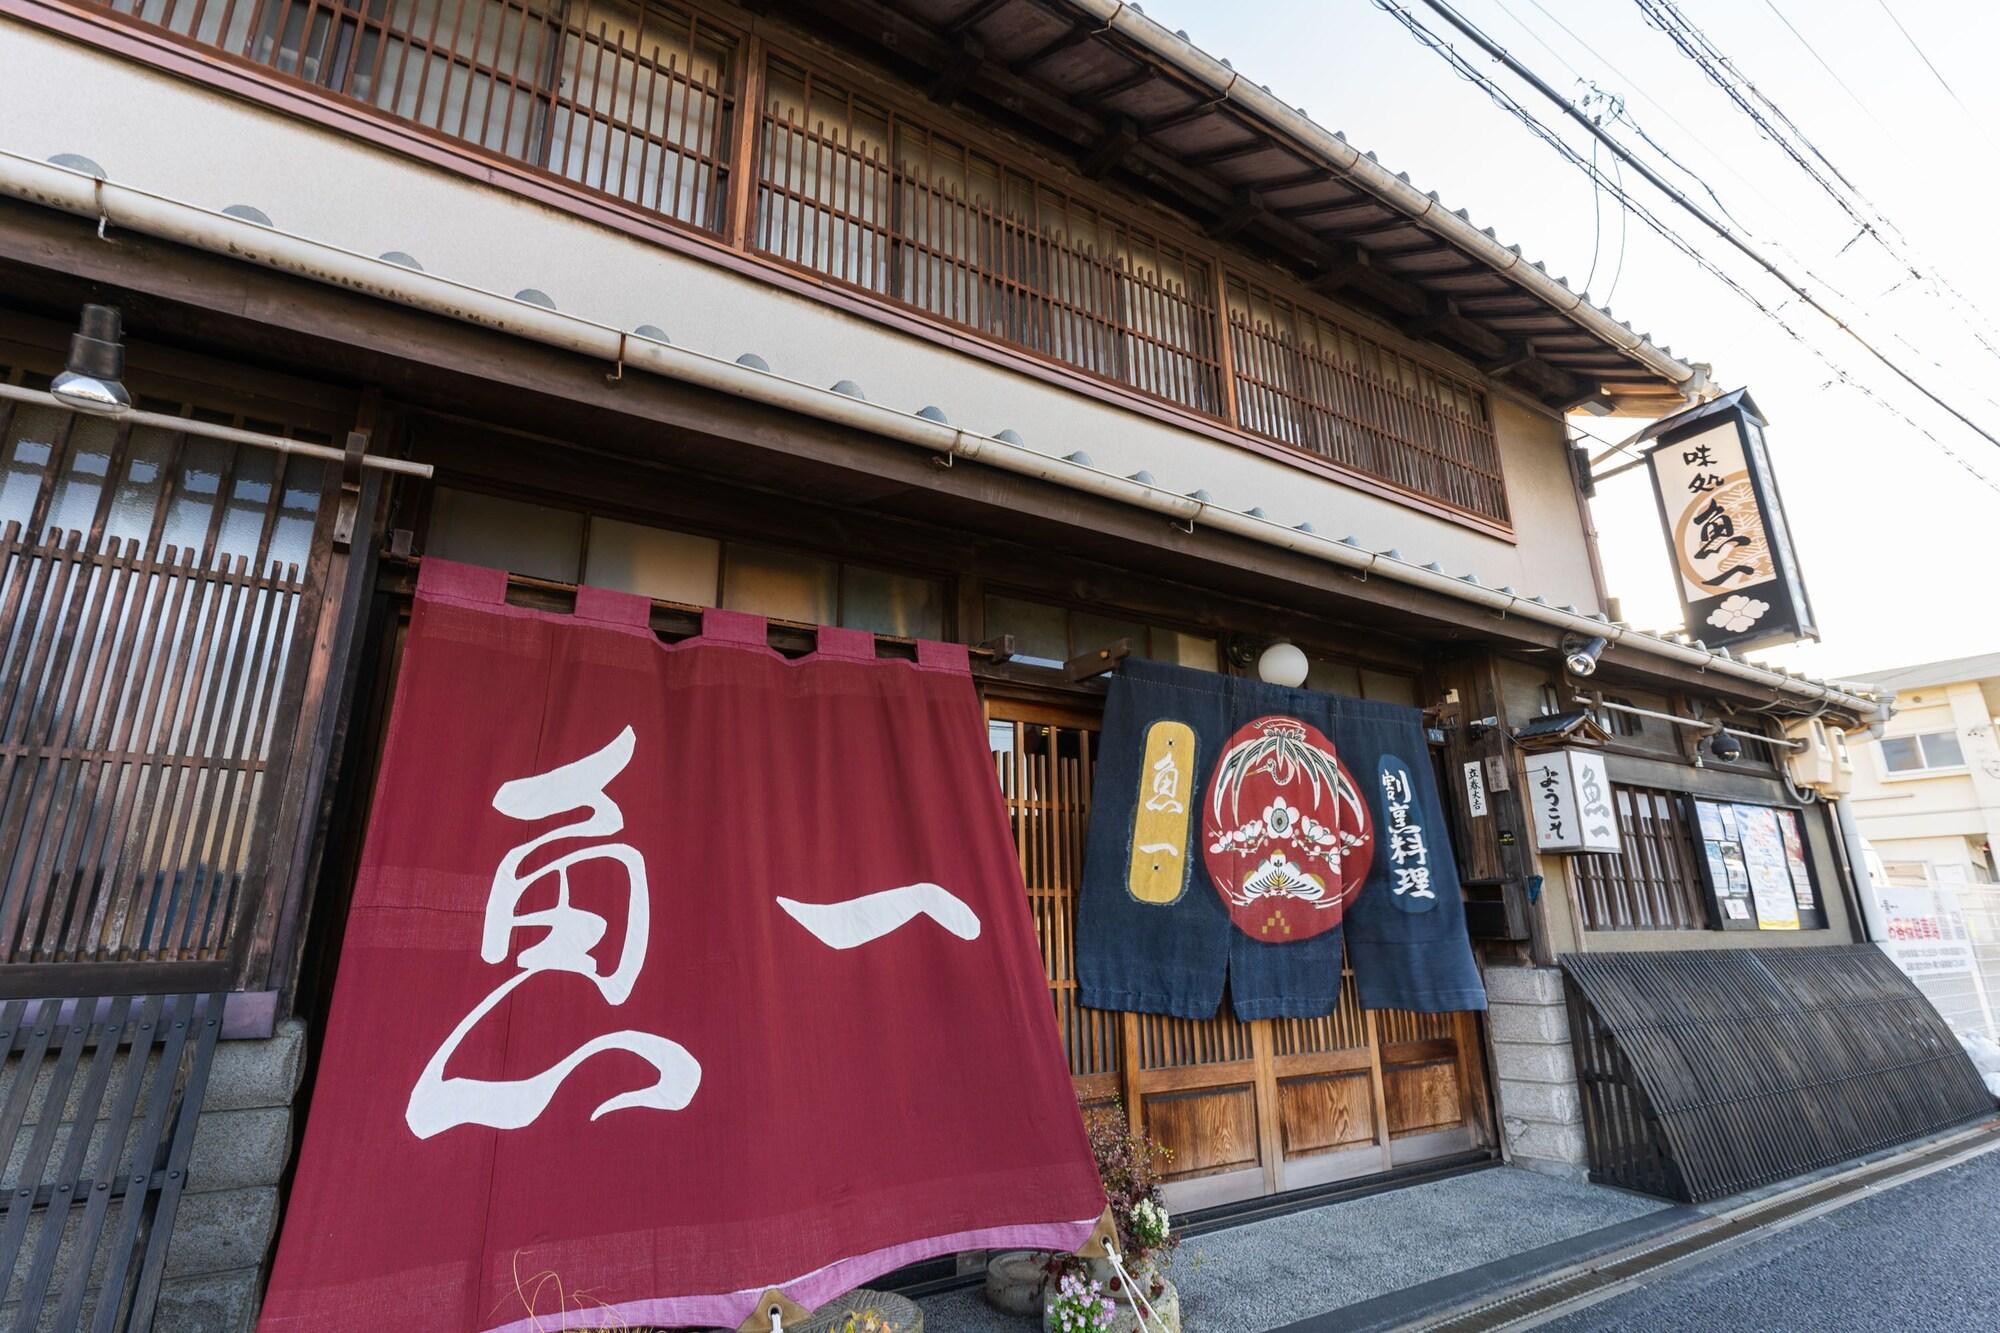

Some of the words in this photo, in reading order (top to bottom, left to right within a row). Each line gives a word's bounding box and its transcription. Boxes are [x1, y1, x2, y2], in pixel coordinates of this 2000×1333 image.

[1139, 751, 1184, 857] 魚一
[1381, 768, 1437, 899] 割烹料理
[1468, 767, 1482, 811] 立春大吉
[1538, 765, 1565, 840] ようこそ
[1582, 762, 1611, 838] 魚一
[405, 725, 981, 1140] 魚一
